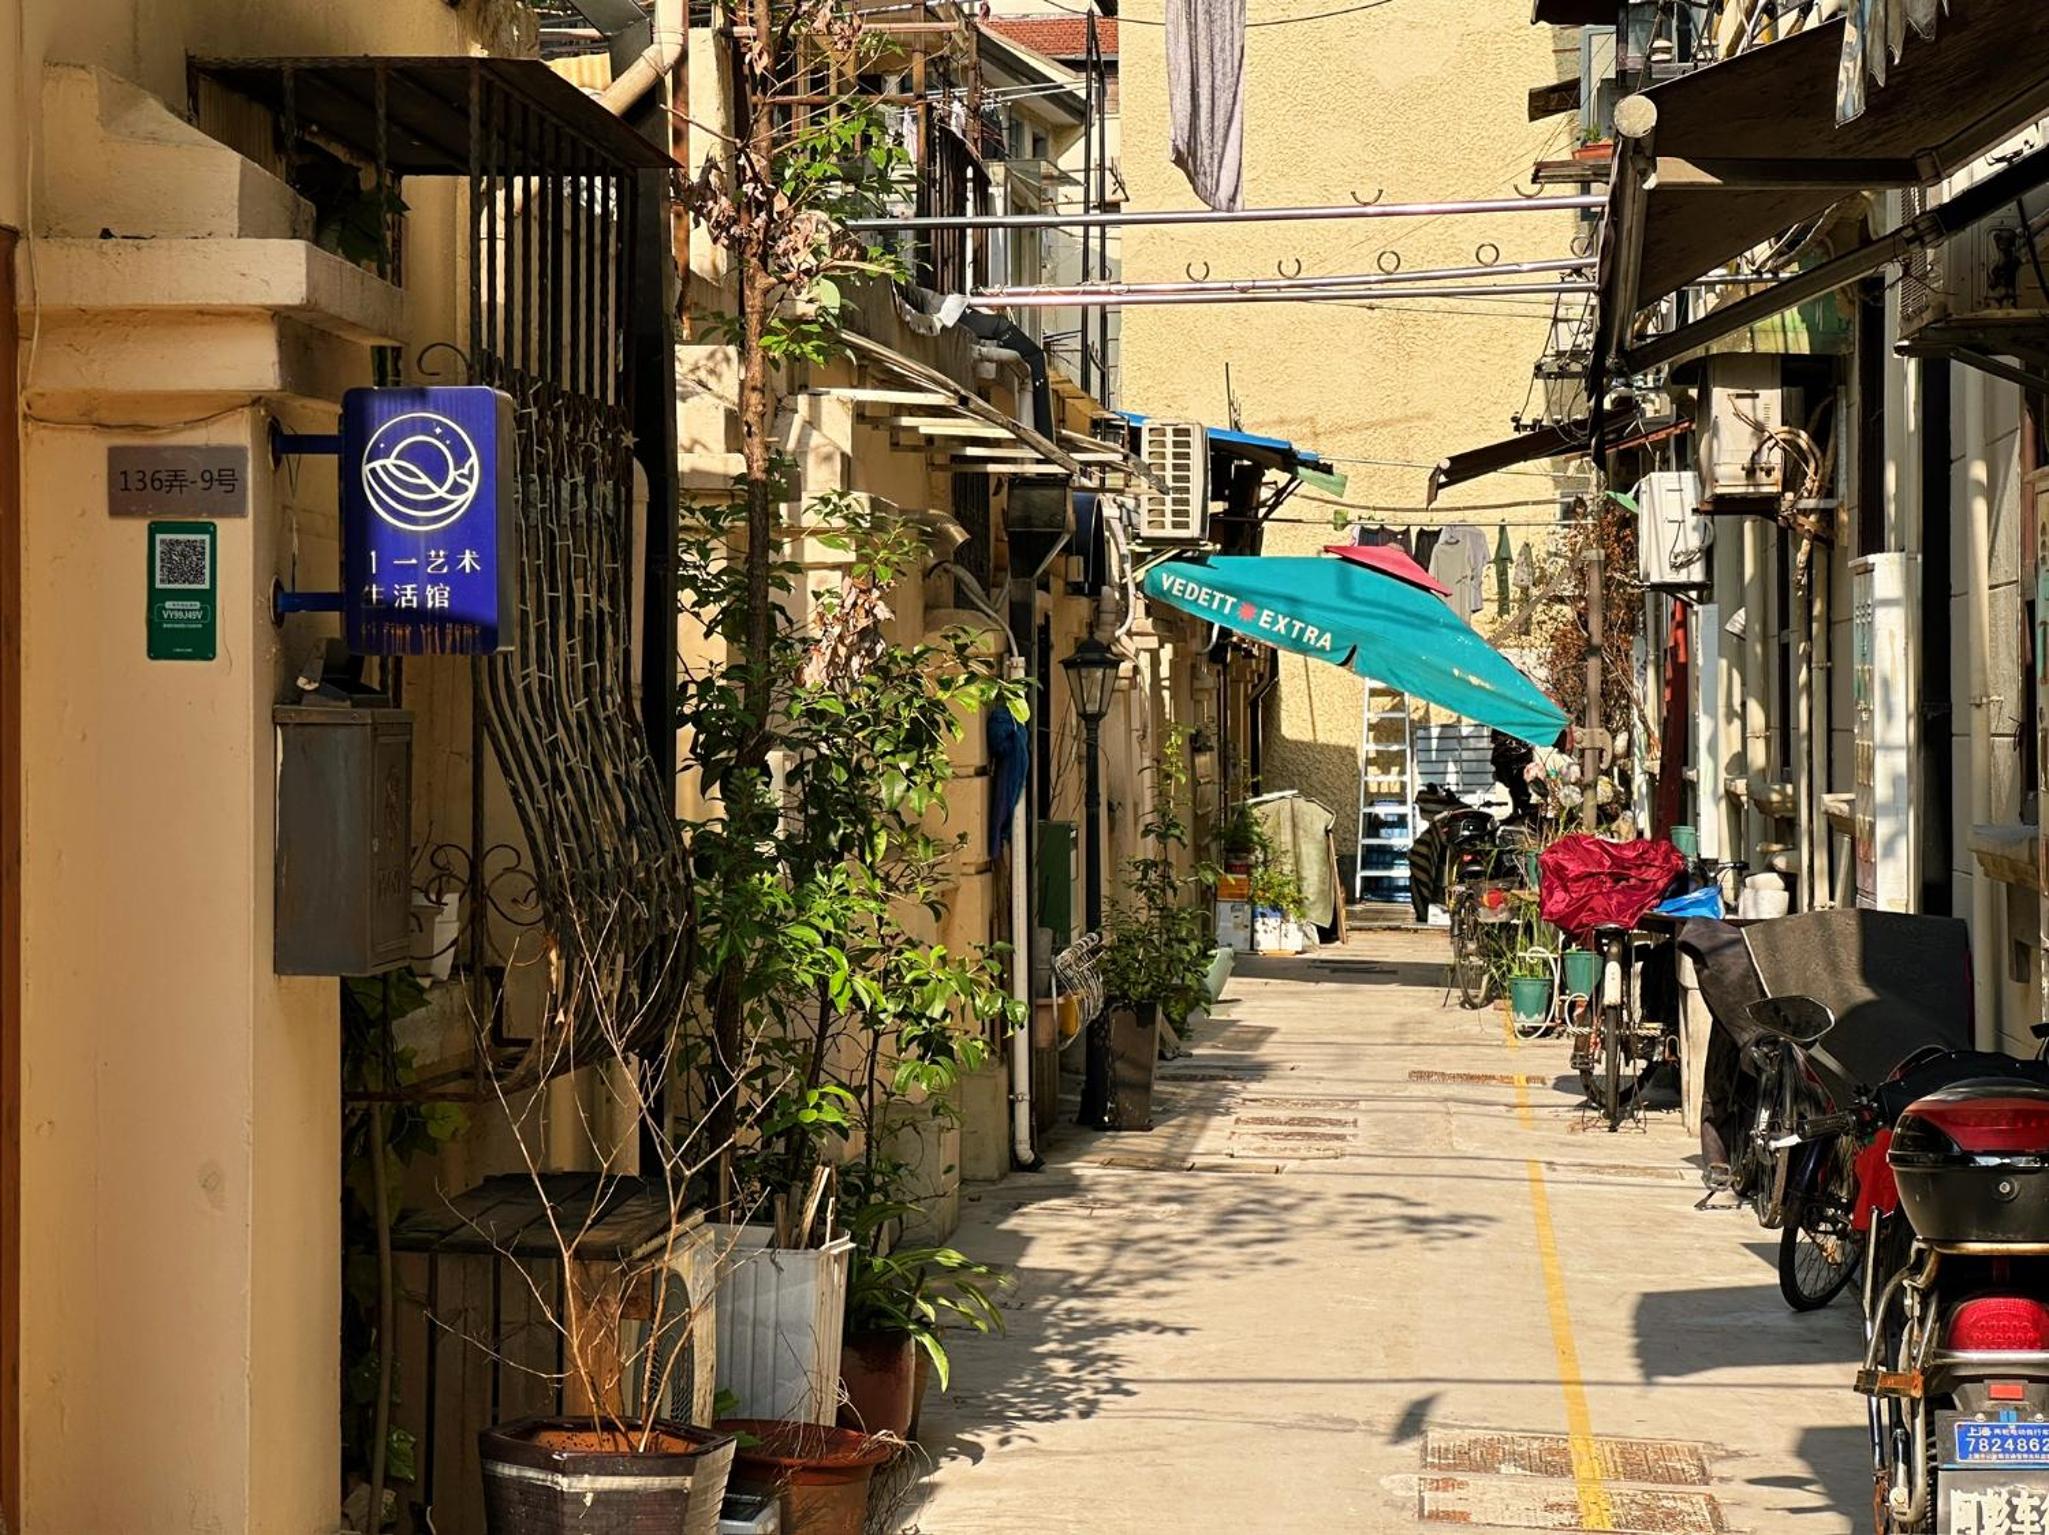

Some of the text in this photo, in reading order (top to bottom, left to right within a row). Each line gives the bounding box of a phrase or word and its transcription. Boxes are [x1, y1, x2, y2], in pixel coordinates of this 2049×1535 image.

[119, 468, 238, 495] 136弄-9号
[360, 583, 451, 609] 生活馆
[1161, 572, 1333, 651] VEDETT EXTRA
